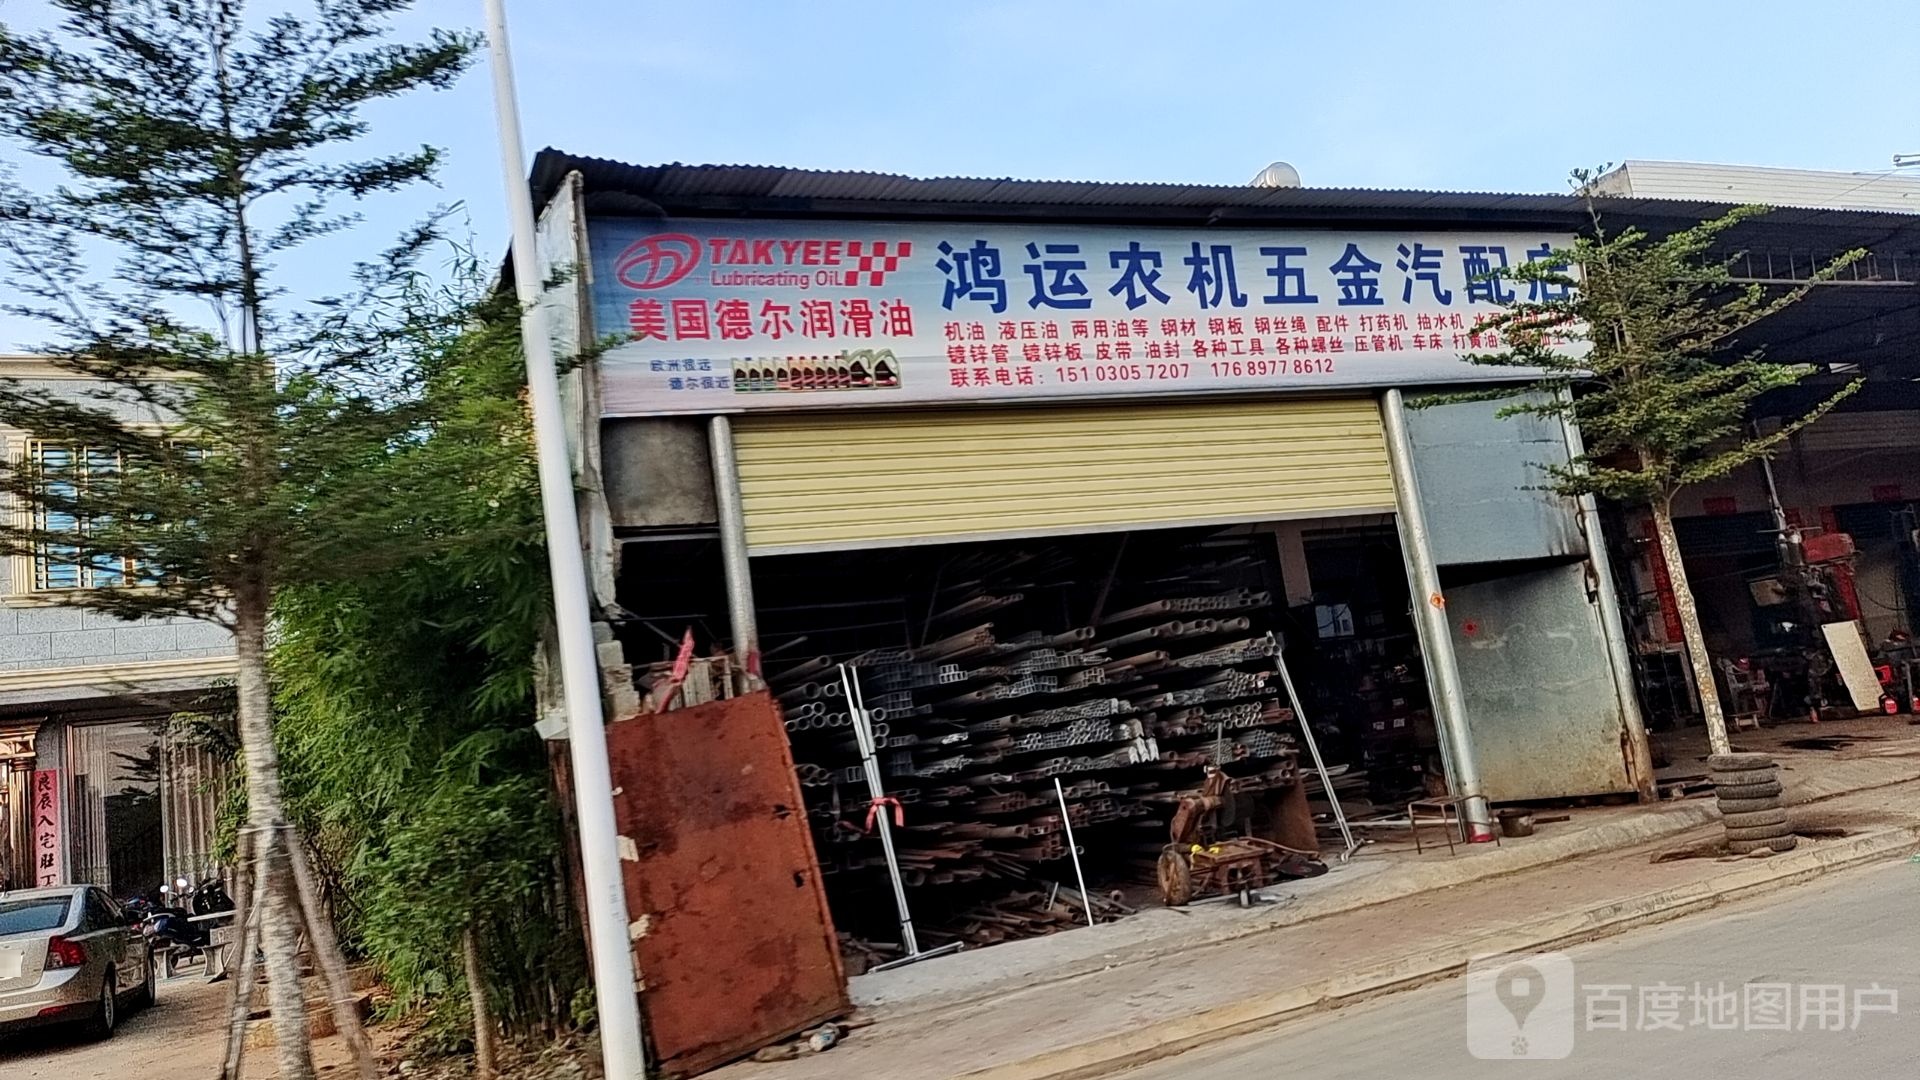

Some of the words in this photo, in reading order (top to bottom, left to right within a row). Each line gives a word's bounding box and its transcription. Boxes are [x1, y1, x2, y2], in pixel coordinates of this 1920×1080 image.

[709, 239, 843, 266] TAKYEE
[711, 269, 810, 290] Lubricating
[935, 238, 1570, 314] 鸿运农机五金汽配店
[629, 298, 914, 341] 美国德尔润滑油
[944, 321, 985, 341] 机油
[998, 320, 1059, 341] 液压油
[1070, 318, 1149, 339] 两用油等
[1160, 317, 1196, 337] 钢材
[1208, 316, 1244, 336] 钢板
[1254, 315, 1307, 335] 钢丝绳
[1316, 314, 1349, 333] 配件
[1359, 313, 1408, 332] 打药机
[1417, 312, 1465, 331] 抽水机
[946, 343, 1009, 364] 镀锌管
[1022, 342, 1083, 363] 镀锌板
[1096, 341, 1132, 361] 皮带
[1144, 339, 1180, 359] 油封
[1192, 338, 1265, 358] 各种工具
[1275, 335, 1345, 356] 各种螺丝
[1354, 334, 1403, 353] 压管机
[1411, 332, 1444, 351] 车床
